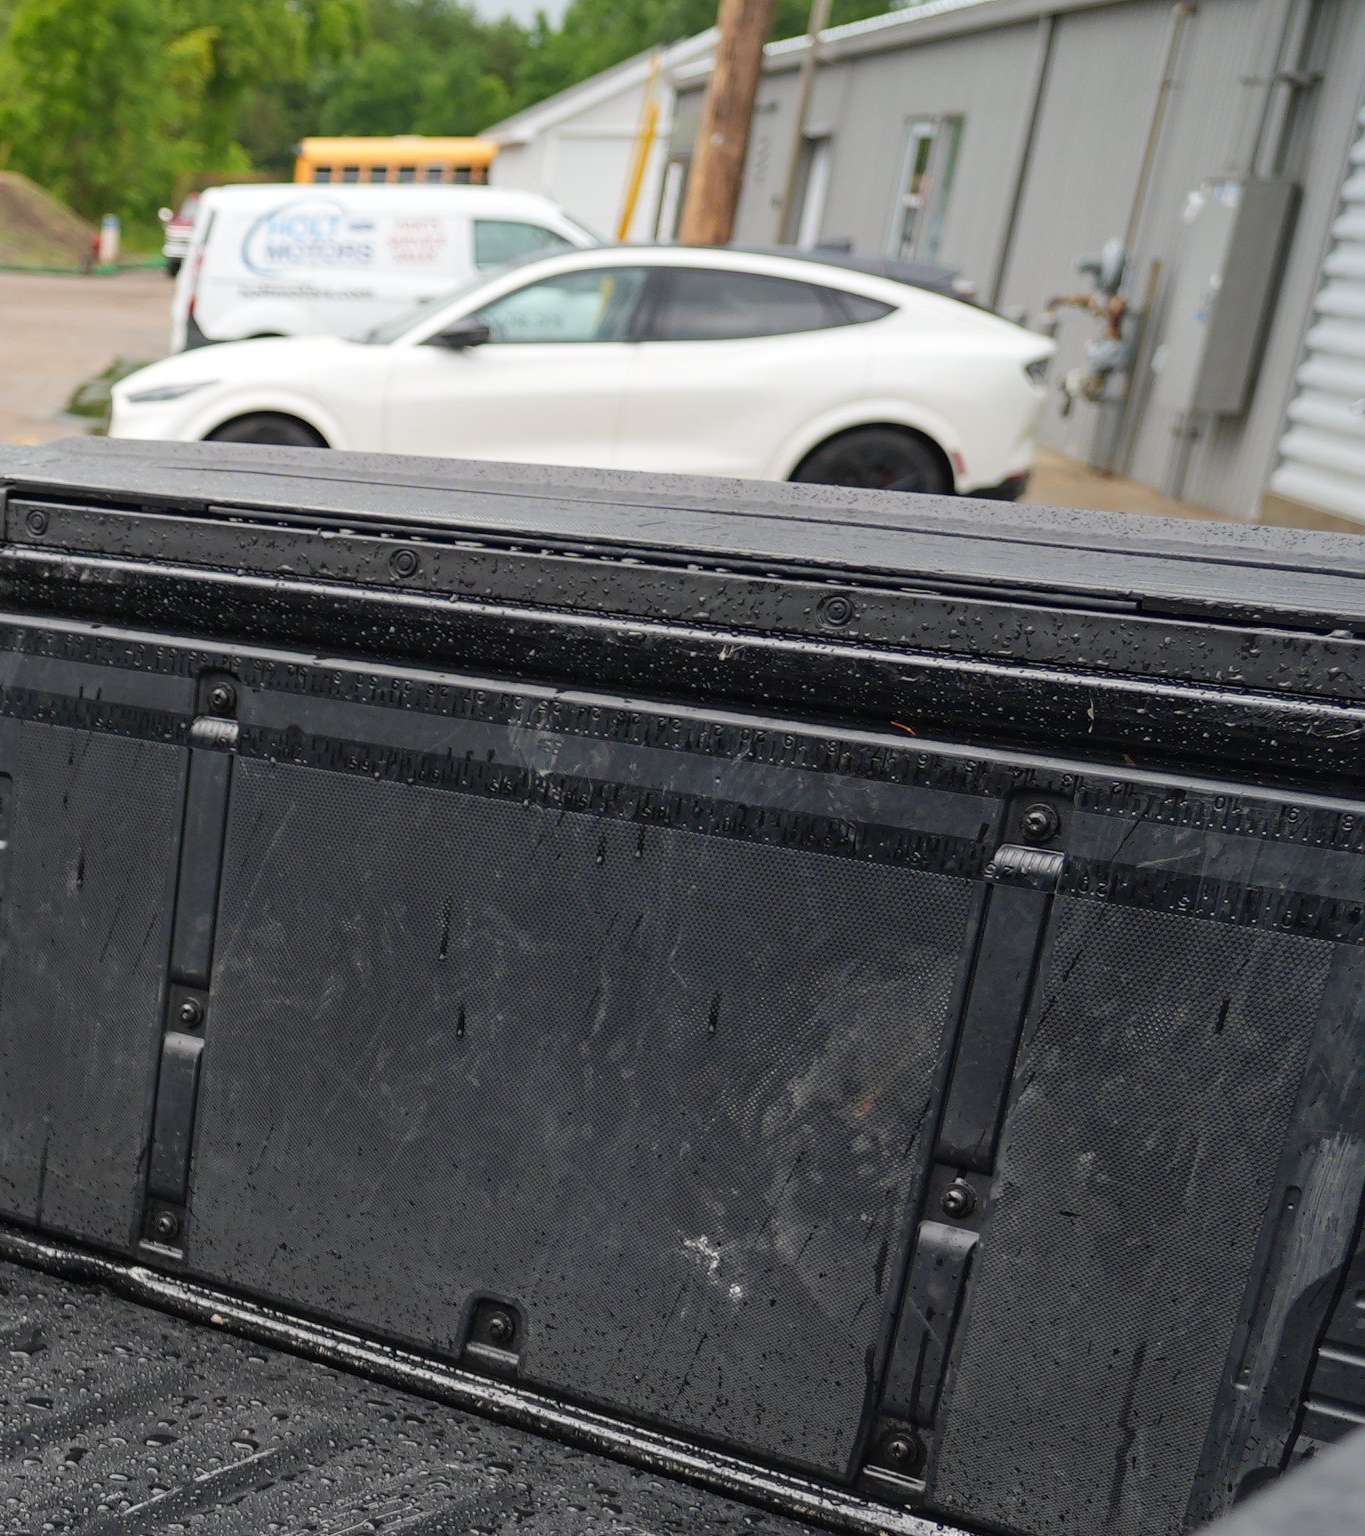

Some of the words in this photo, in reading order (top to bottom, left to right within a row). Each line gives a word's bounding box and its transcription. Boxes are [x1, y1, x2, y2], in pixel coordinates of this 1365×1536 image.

[267, 215, 342, 238] HOLT
[265, 239, 375, 264] MOTORS
[391, 678, 414, 694] 29
[426, 683, 449, 698] 28
[462, 689, 486, 704] 27
[538, 700, 563, 715] 25
[656, 716, 683, 733] 22
[700, 720, 723, 738] 21
[740, 727, 769, 744] 20
[826, 740, 851, 757] 18
[871, 746, 895, 764] 17
[1213, 795, 1241, 814] 10
[1287, 806, 1301, 824] 9
[1341, 814, 1354, 831] 8
